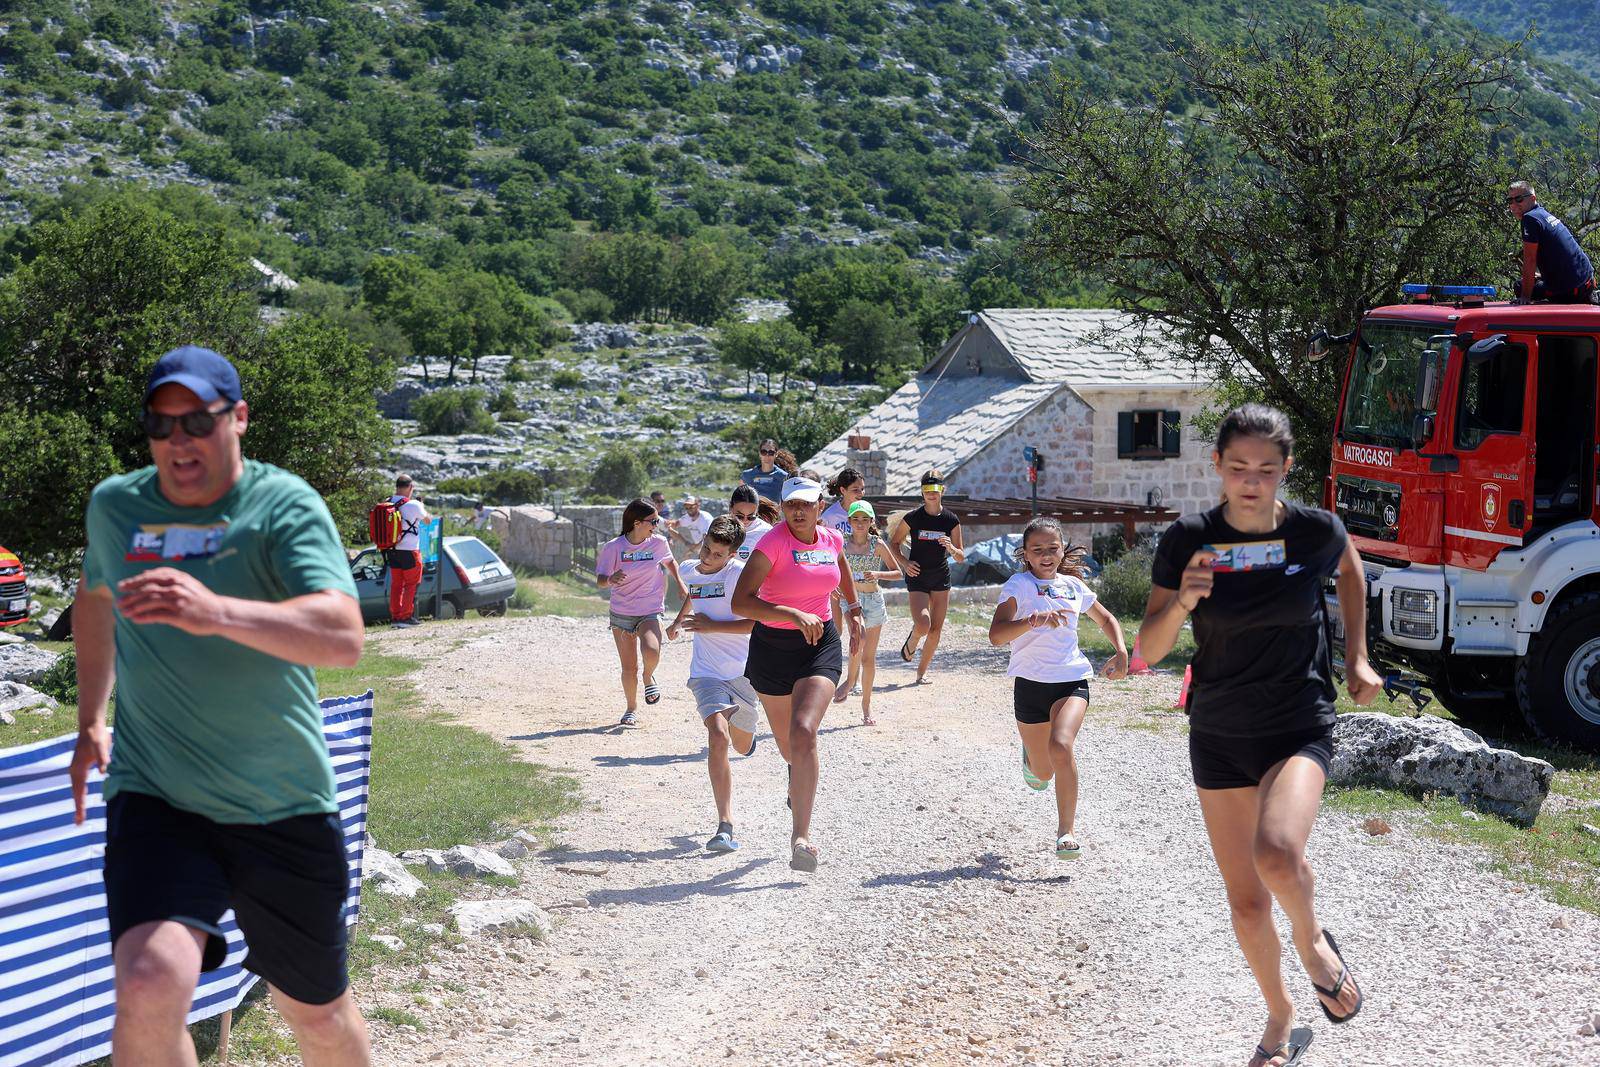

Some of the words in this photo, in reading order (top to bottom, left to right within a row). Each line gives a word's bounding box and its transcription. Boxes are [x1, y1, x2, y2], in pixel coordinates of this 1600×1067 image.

[1343, 445, 1393, 467] VATROGASCI
[1353, 498, 1375, 515] MAN
[1236, 545, 1250, 565] 4
